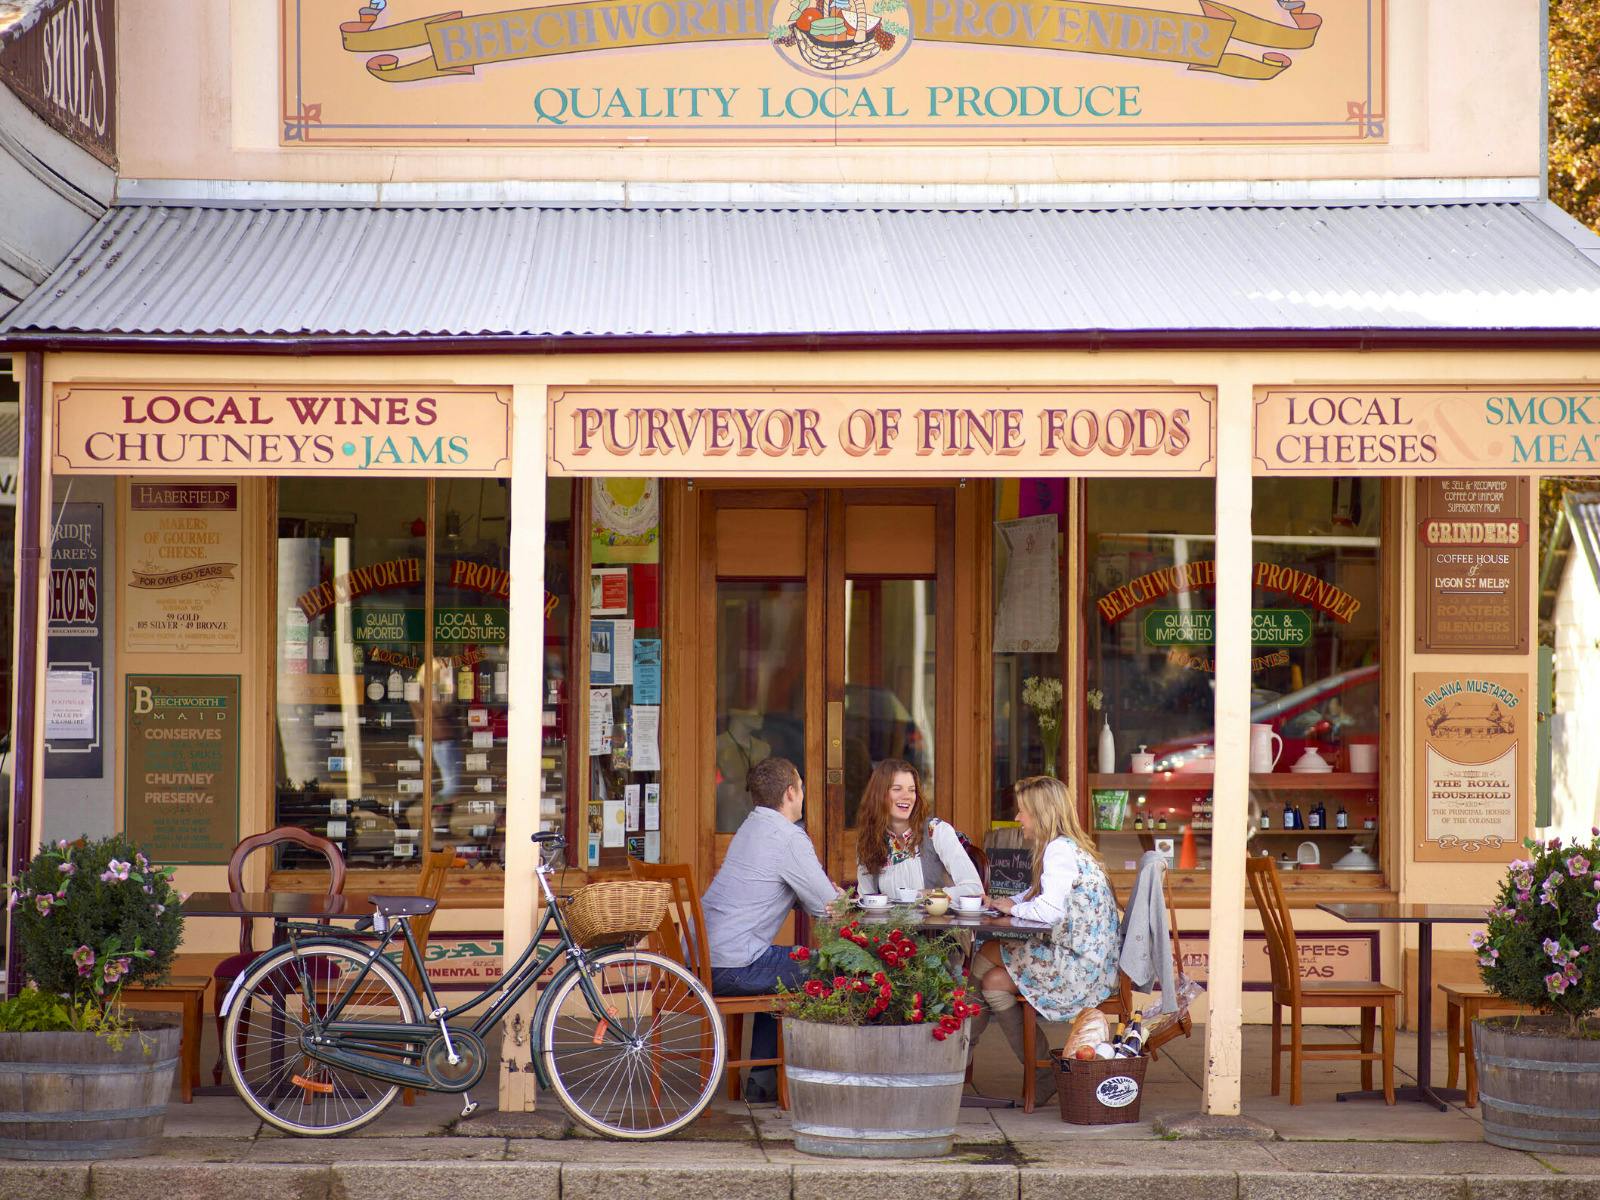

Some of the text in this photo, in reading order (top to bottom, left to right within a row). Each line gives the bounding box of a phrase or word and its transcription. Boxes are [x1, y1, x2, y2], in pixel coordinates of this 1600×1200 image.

[439, 0, 1214, 64] BEECHWORTH PROVENDER
[42, 0, 107, 136] SHOES
[534, 86, 1143, 125] QUALITY LOCAL PRODUCE
[122, 396, 438, 425] LOCAL WINES
[1286, 397, 1413, 425] LOCAL
[1485, 396, 1600, 425] SMOK
[570, 408, 1191, 457] PURVEYOR OF FINE FOODS
[84, 432, 470, 469] CHUTNEYS JAMS
[1275, 434, 1437, 463] CHEESES
[1452, 481, 1464, 490] SELL
[1445, 492, 1467, 501] COFFEE
[1448, 503, 1500, 512] SUPERIORITY FROM
[159, 517, 208, 530] MAKERS
[144, 532, 221, 545] OF GOURMET
[1427, 522, 1520, 543] GRINDERS
[1437, 554, 1510, 564] COFFEE HOUSE
[139, 567, 223, 586] FOR OVER 60 YEARS
[1435, 577, 1462, 588] LYGON
[1097, 560, 1361, 623] BEECHWORTH PROVENDER
[177, 613, 200, 621] GOLD
[1437, 605, 1510, 616] ROASTERS
[150, 622, 178, 630] SILVER
[196, 622, 228, 630] BRONZE
[366, 613, 405, 626] QUALITY
[440, 613, 478, 626] LOCAL
[1164, 614, 1211, 628] QUALITY
[356, 627, 506, 639] IMPORTED FOODSTUFFS
[1437, 621, 1510, 632] BLENDERS
[1156, 628, 1303, 641] IMPORTED ODSTUFFS
[133, 685, 219, 714] BEECHWORTH
[1424, 680, 1519, 708] MILAWA MUSTARDS
[144, 728, 222, 740] CONSERVES
[145, 773, 214, 785] CHUTNEY
[1432, 791, 1511, 799] HOUSEHOLD
[1300, 966, 1335, 978] EAS
